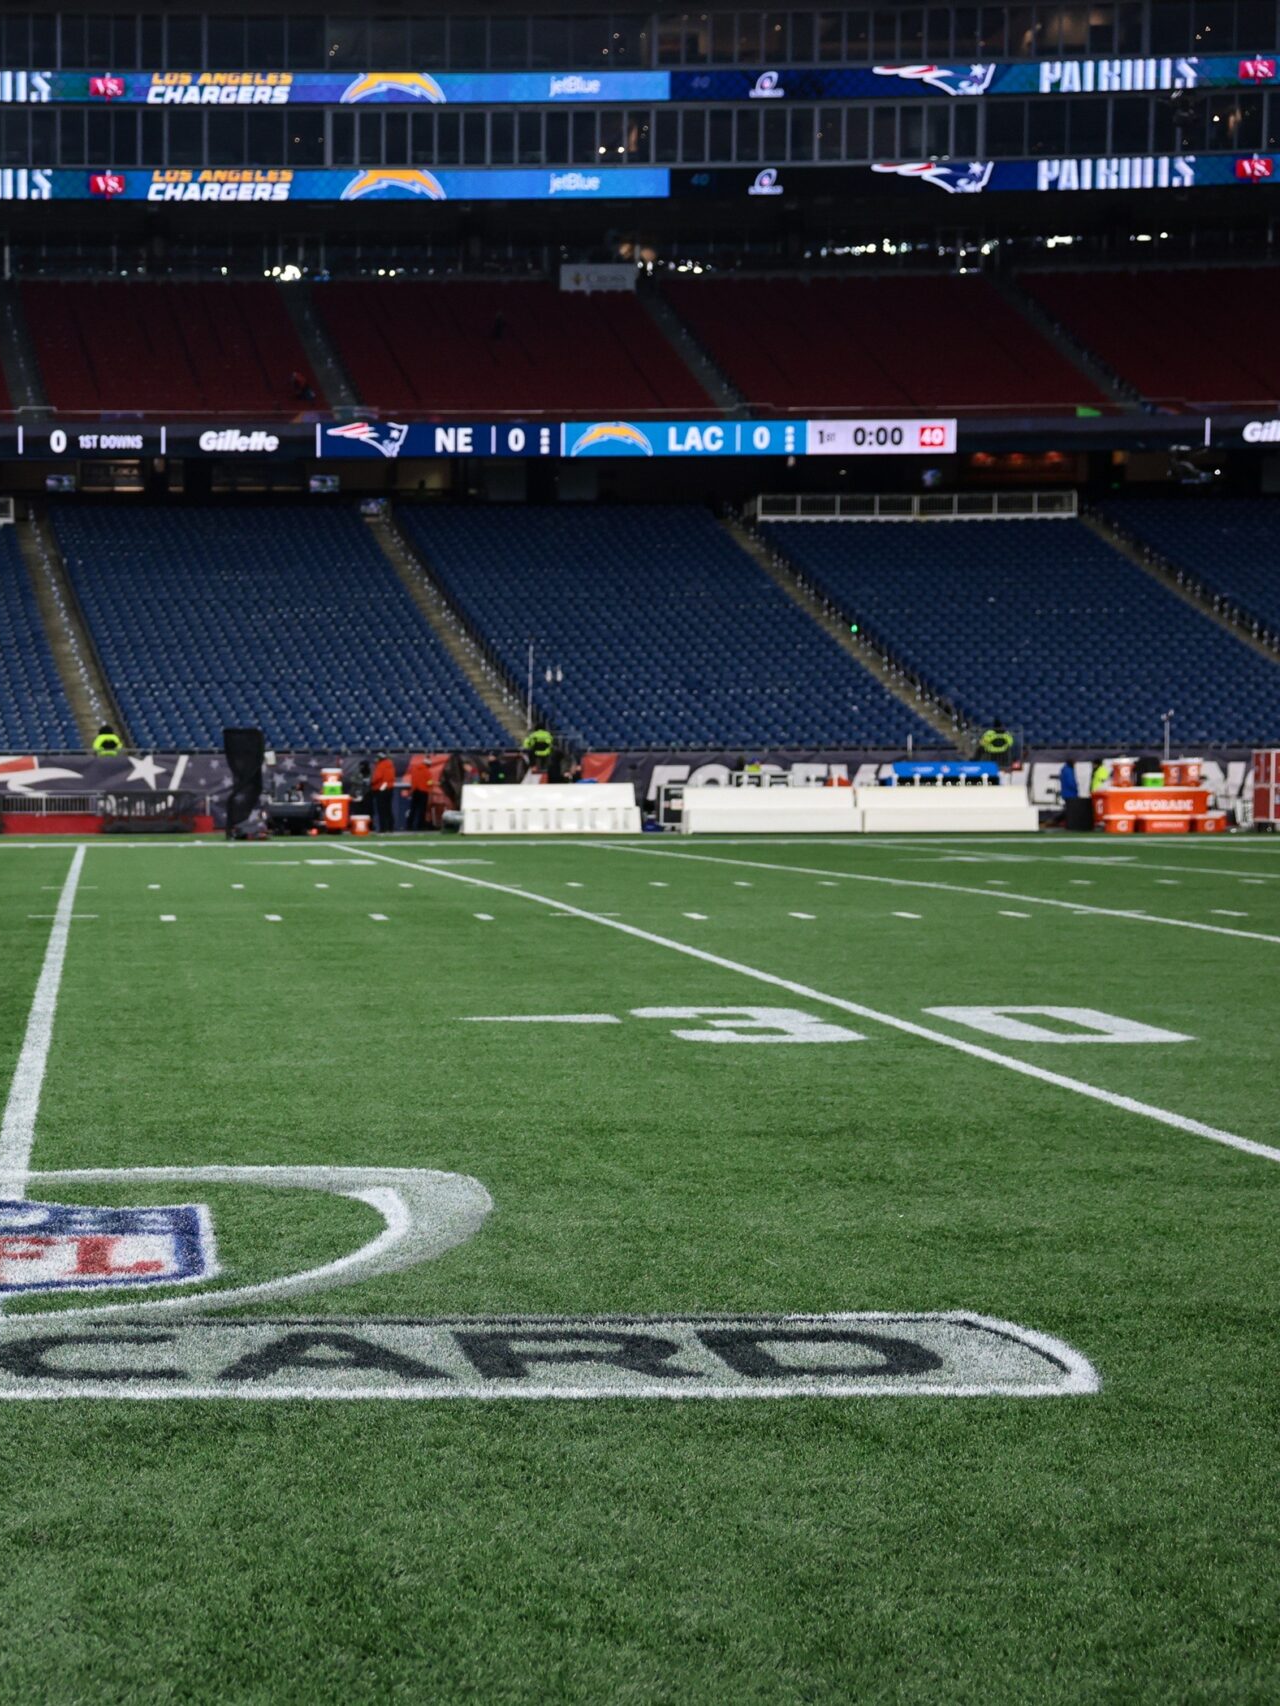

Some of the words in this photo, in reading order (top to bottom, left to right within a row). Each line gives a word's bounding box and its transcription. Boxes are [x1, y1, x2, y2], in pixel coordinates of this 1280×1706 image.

[151, 72, 192, 86] LOS
[197, 72, 294, 87] ANGELES
[548, 75, 601, 97] jetBlue
[146, 86, 291, 104] CHARGERS
[152, 170, 193, 183] LOS
[198, 170, 294, 183] ANGELES
[548, 172, 601, 194] jetBlue
[147, 183, 291, 201] CHARGERS
[50, 429, 67, 453] 0
[79, 434, 98, 450] 1ST
[100, 434, 143, 450] DOWNS
[199, 429, 279, 452] Gillette
[435, 428, 473, 453] NE
[507, 427, 526, 452] 0
[668, 427, 724, 452] LAC
[753, 425, 771, 450] 0
[853, 426, 904, 446] 0:00
[920, 427, 944, 446] 40
[325, 803, 343, 822] G
[1124, 799, 1193, 812] GATORADE
